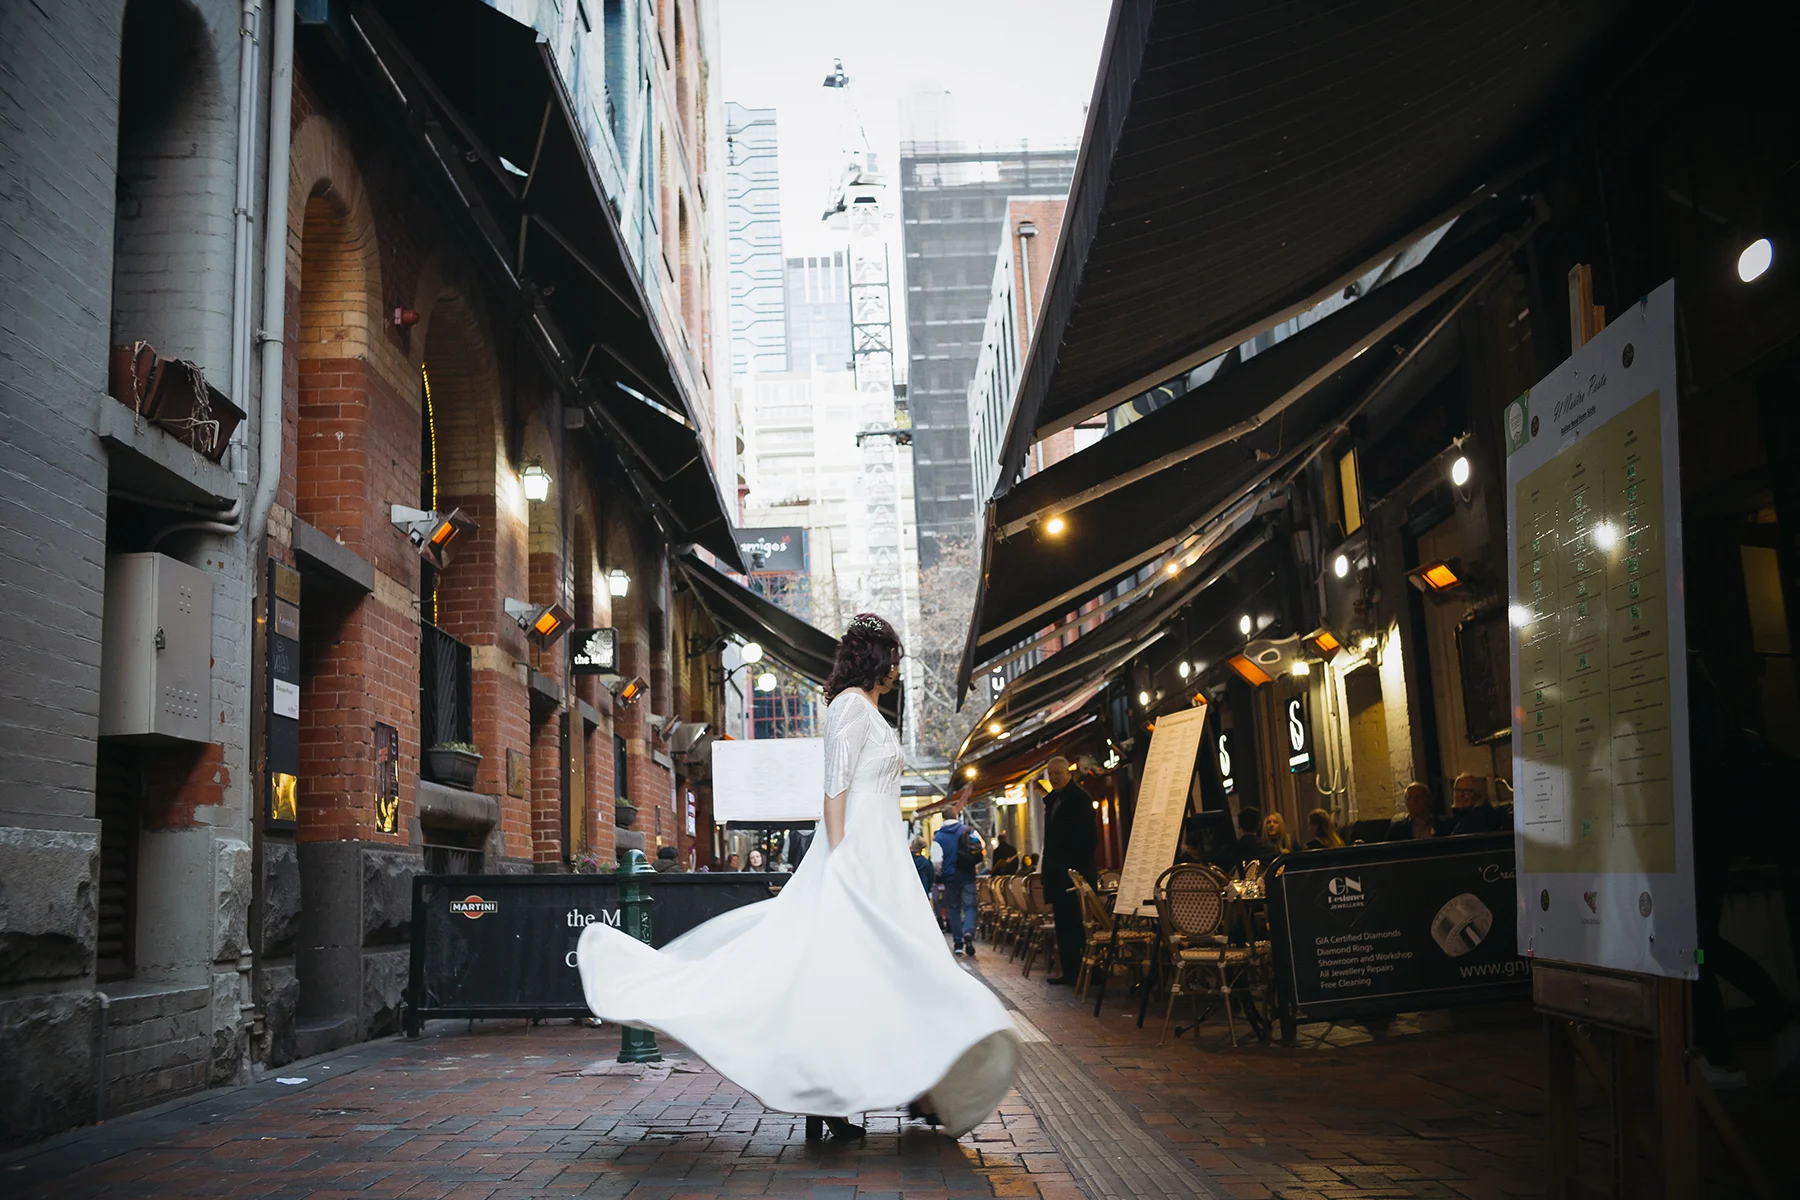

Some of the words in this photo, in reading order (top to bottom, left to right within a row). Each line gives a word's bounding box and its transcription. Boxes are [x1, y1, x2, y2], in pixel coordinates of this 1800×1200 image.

[740, 537, 788, 558] amigos
[574, 654, 590, 665] the
[1328, 876, 1363, 895] GN
[1327, 893, 1365, 904] Designer
[452, 902, 495, 911] MARTINI
[566, 908, 596, 927] the
[602, 909, 622, 927] M
[1315, 936, 1330, 946] GIA
[1330, 933, 1363, 944] Certified
[1363, 929, 1401, 941] Diamonds
[1317, 944, 1351, 956] Diamond
[1352, 944, 1374, 954] Rings
[1318, 956, 1359, 968] Showroom
[1360, 954, 1375, 963] and
[1375, 950, 1413, 962] Workshop
[1319, 969, 1330, 978] All
[1330, 966, 1366, 978] Jewellery
[1366, 964, 1395, 975] Repairs
[1460, 960, 1533, 978] www.gnj
[1320, 980, 1337, 989] Free
[1338, 976, 1372, 988] Cleaning
